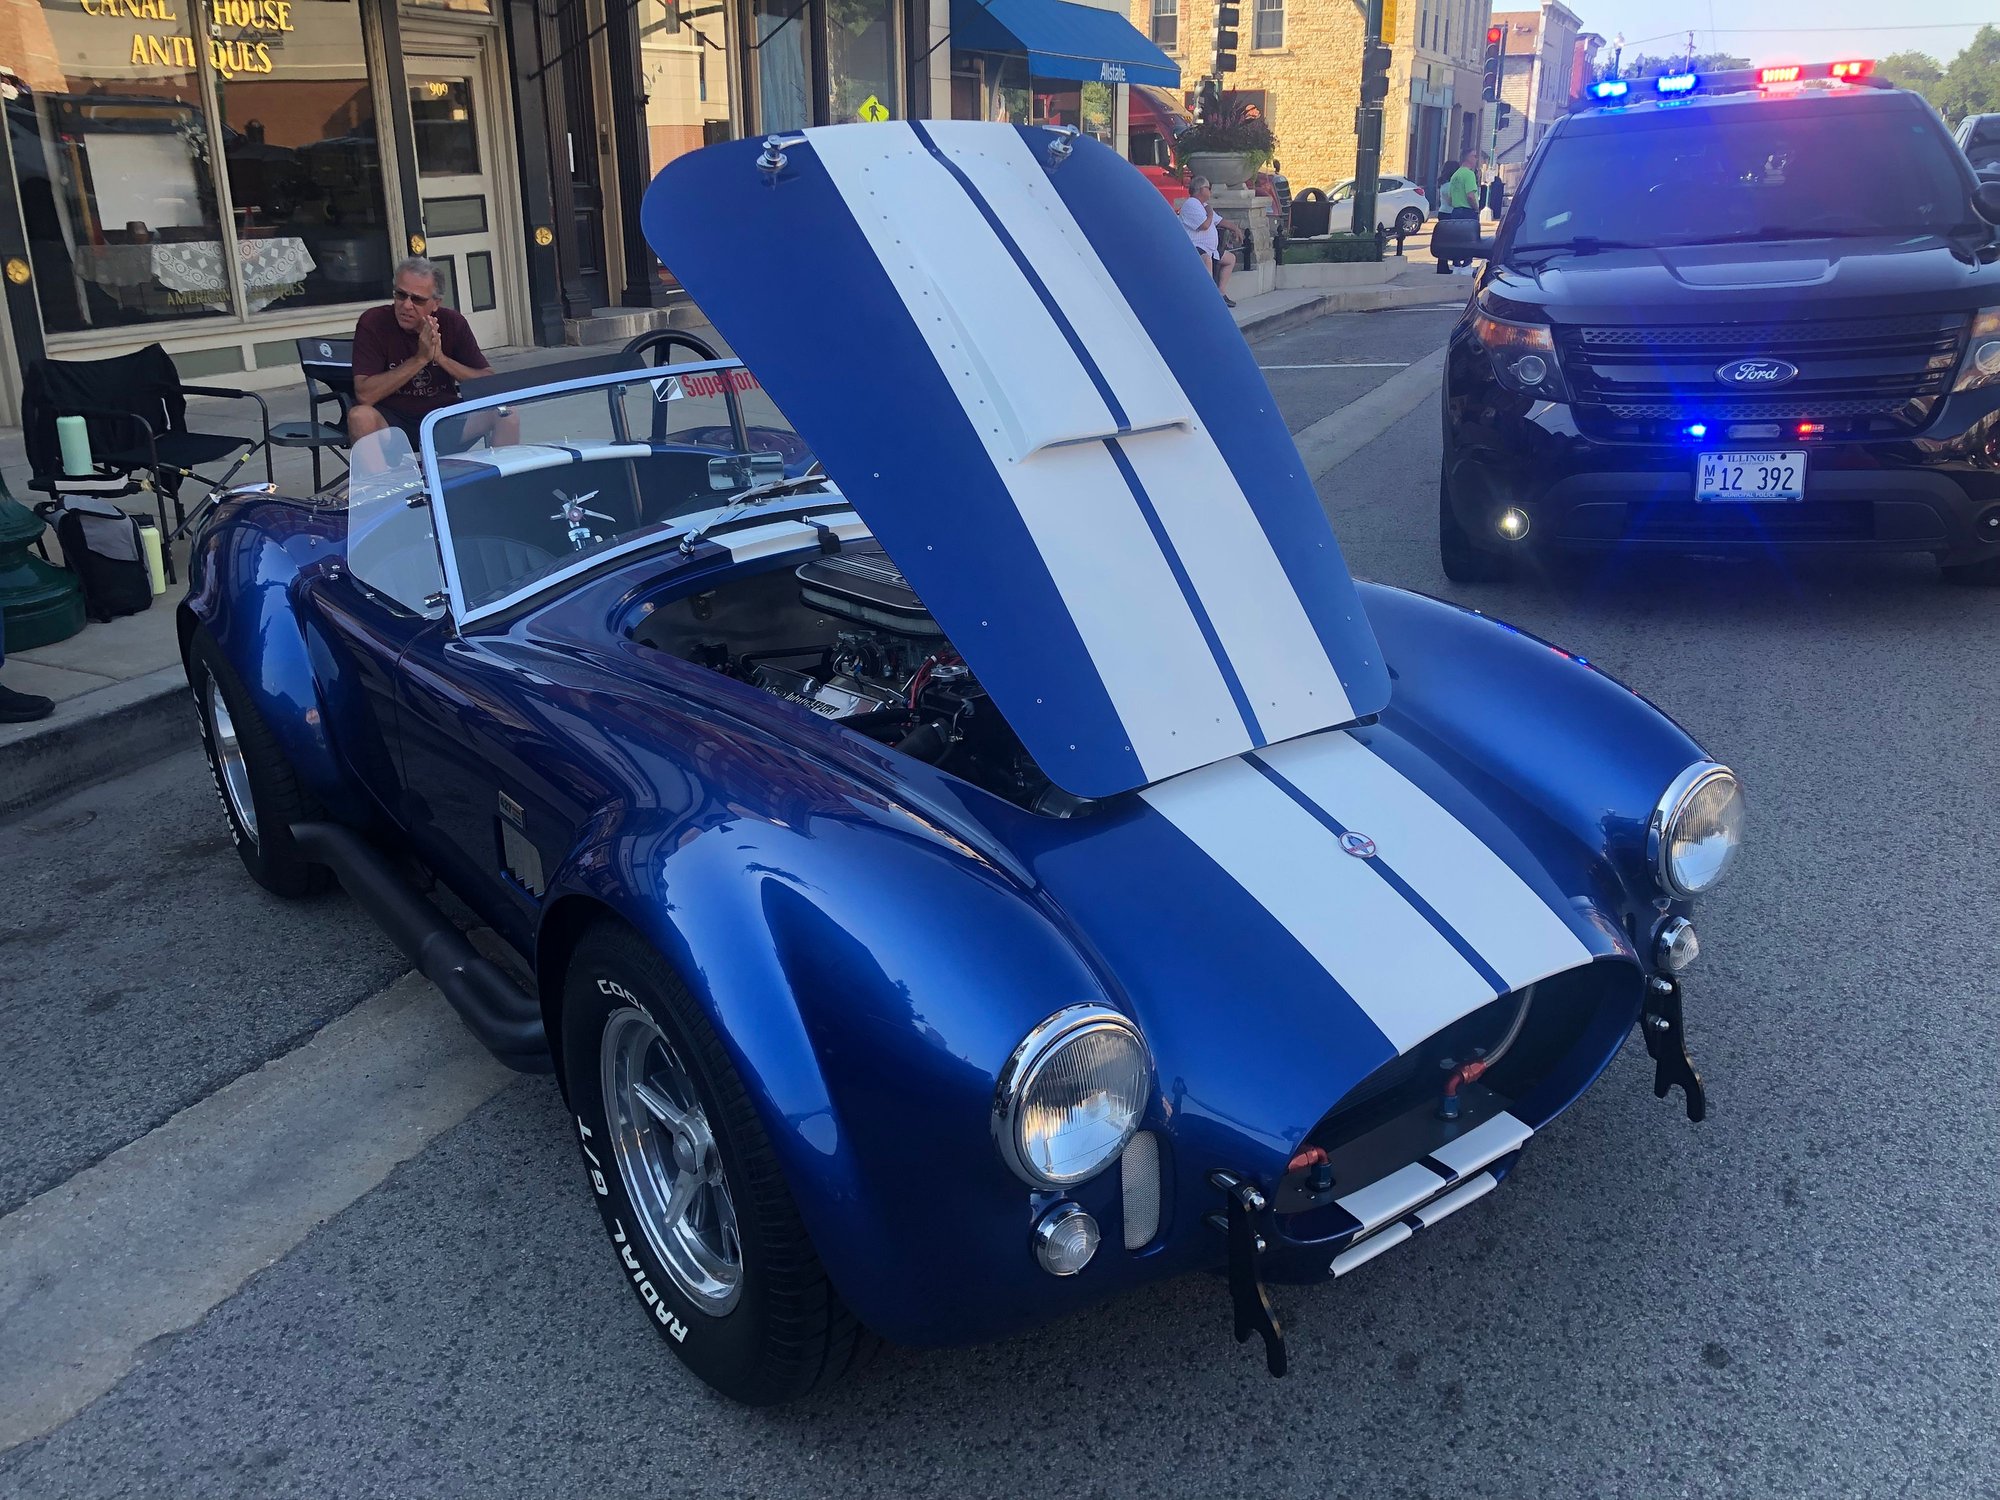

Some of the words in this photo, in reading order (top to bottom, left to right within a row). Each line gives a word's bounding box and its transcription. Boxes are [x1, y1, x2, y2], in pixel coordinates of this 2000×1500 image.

[81, 0, 176, 21] CANAL
[212, 0, 294, 32] HOUSE
[131, 34, 273, 79] ANTIQUES
[1100, 62, 1126, 82] Allstate
[429, 82, 449, 97] 909
[167, 288, 232, 306] AMERICAN
[1735, 362, 1779, 380] Ford
[1727, 454, 1776, 463] ILLINOIS
[1719, 467, 1743, 490] 12
[1757, 467, 1794, 490] 392
[577, 1114, 609, 1196] G/T
[613, 1218, 689, 1344] RADIAL
